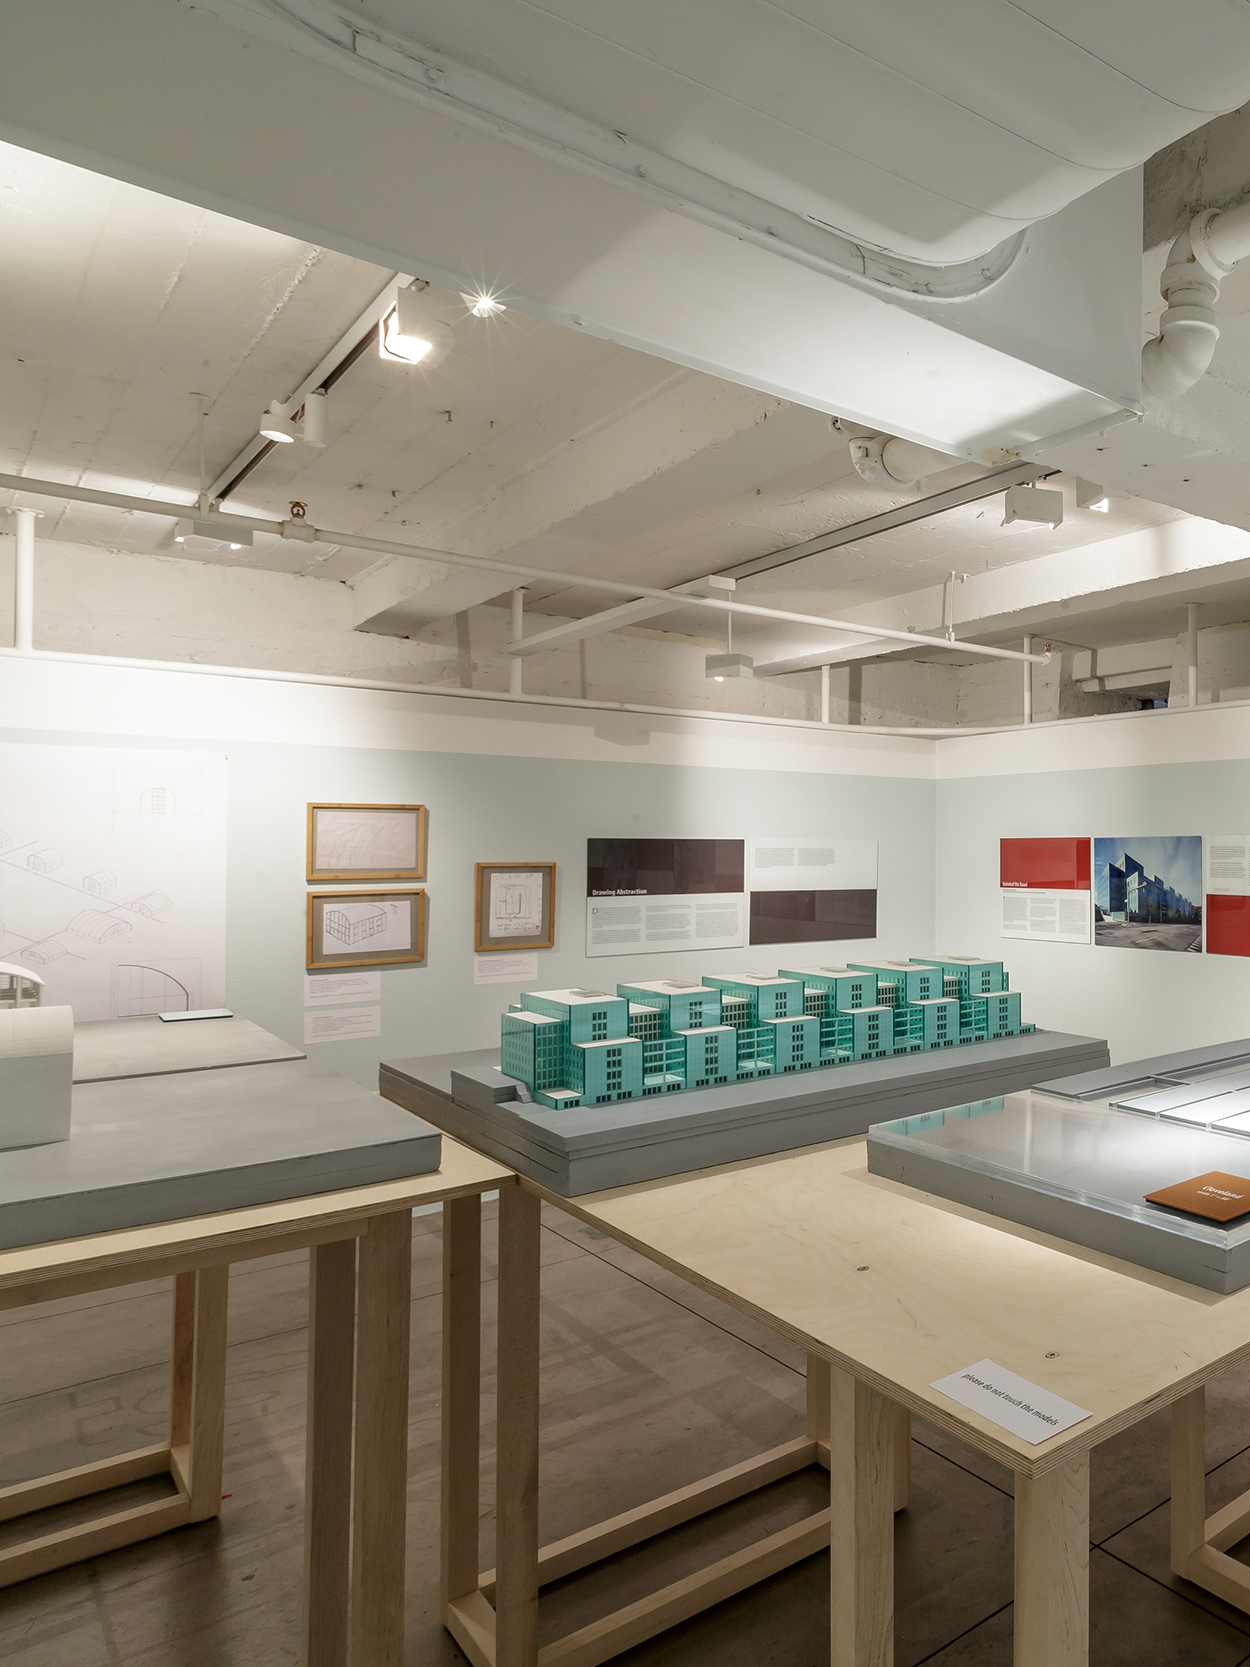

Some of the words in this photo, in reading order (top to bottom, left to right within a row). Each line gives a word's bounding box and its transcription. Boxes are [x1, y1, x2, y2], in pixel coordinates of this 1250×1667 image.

[592, 889, 616, 897] Drawing
[1202, 1185, 1244, 1199] Cleveland
[960, 1373, 985, 1386] please
[982, 1383, 994, 1391] do
[990, 1388, 1005, 1397] not
[1002, 1394, 1024, 1407] touch
[1020, 1403, 1035, 1413] the
[1031, 1410, 1059, 1426] models
